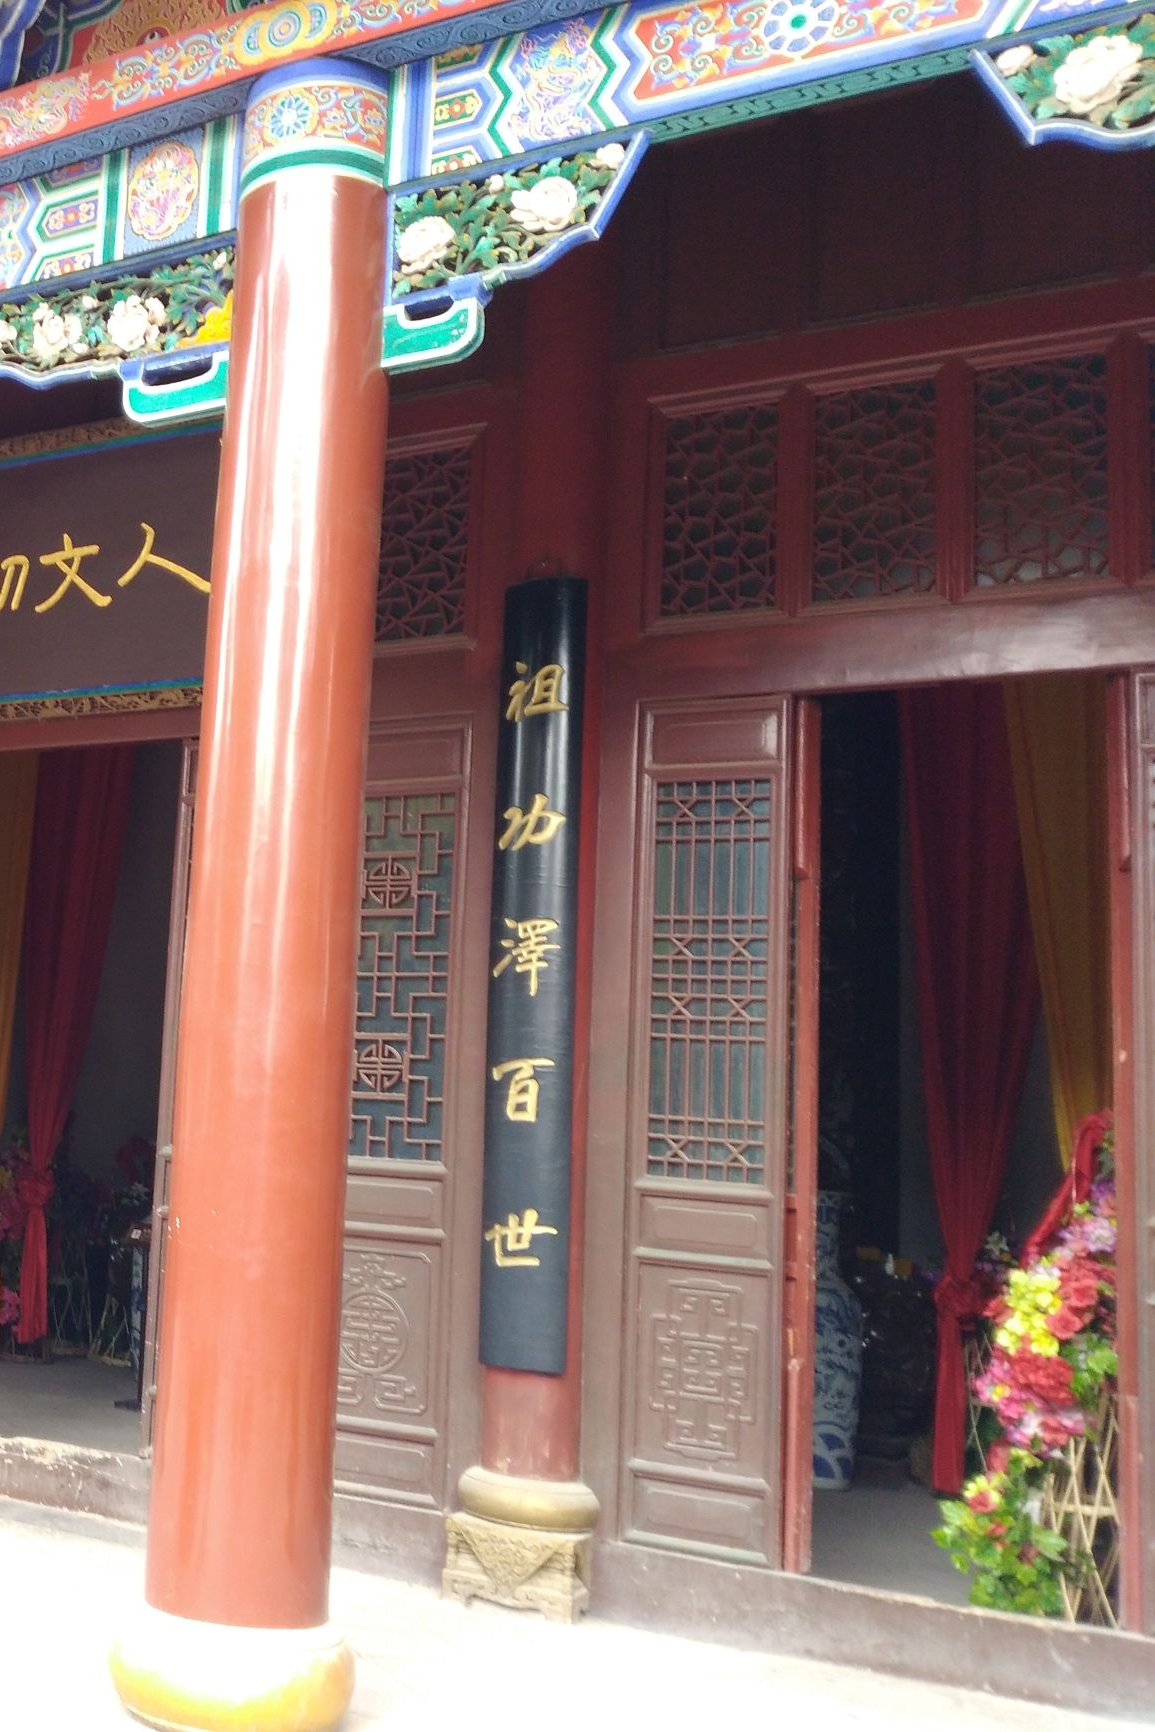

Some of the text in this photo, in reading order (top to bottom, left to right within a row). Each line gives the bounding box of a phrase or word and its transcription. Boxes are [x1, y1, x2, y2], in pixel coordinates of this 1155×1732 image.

[484, 661, 569, 1268] 祖功澤百世
